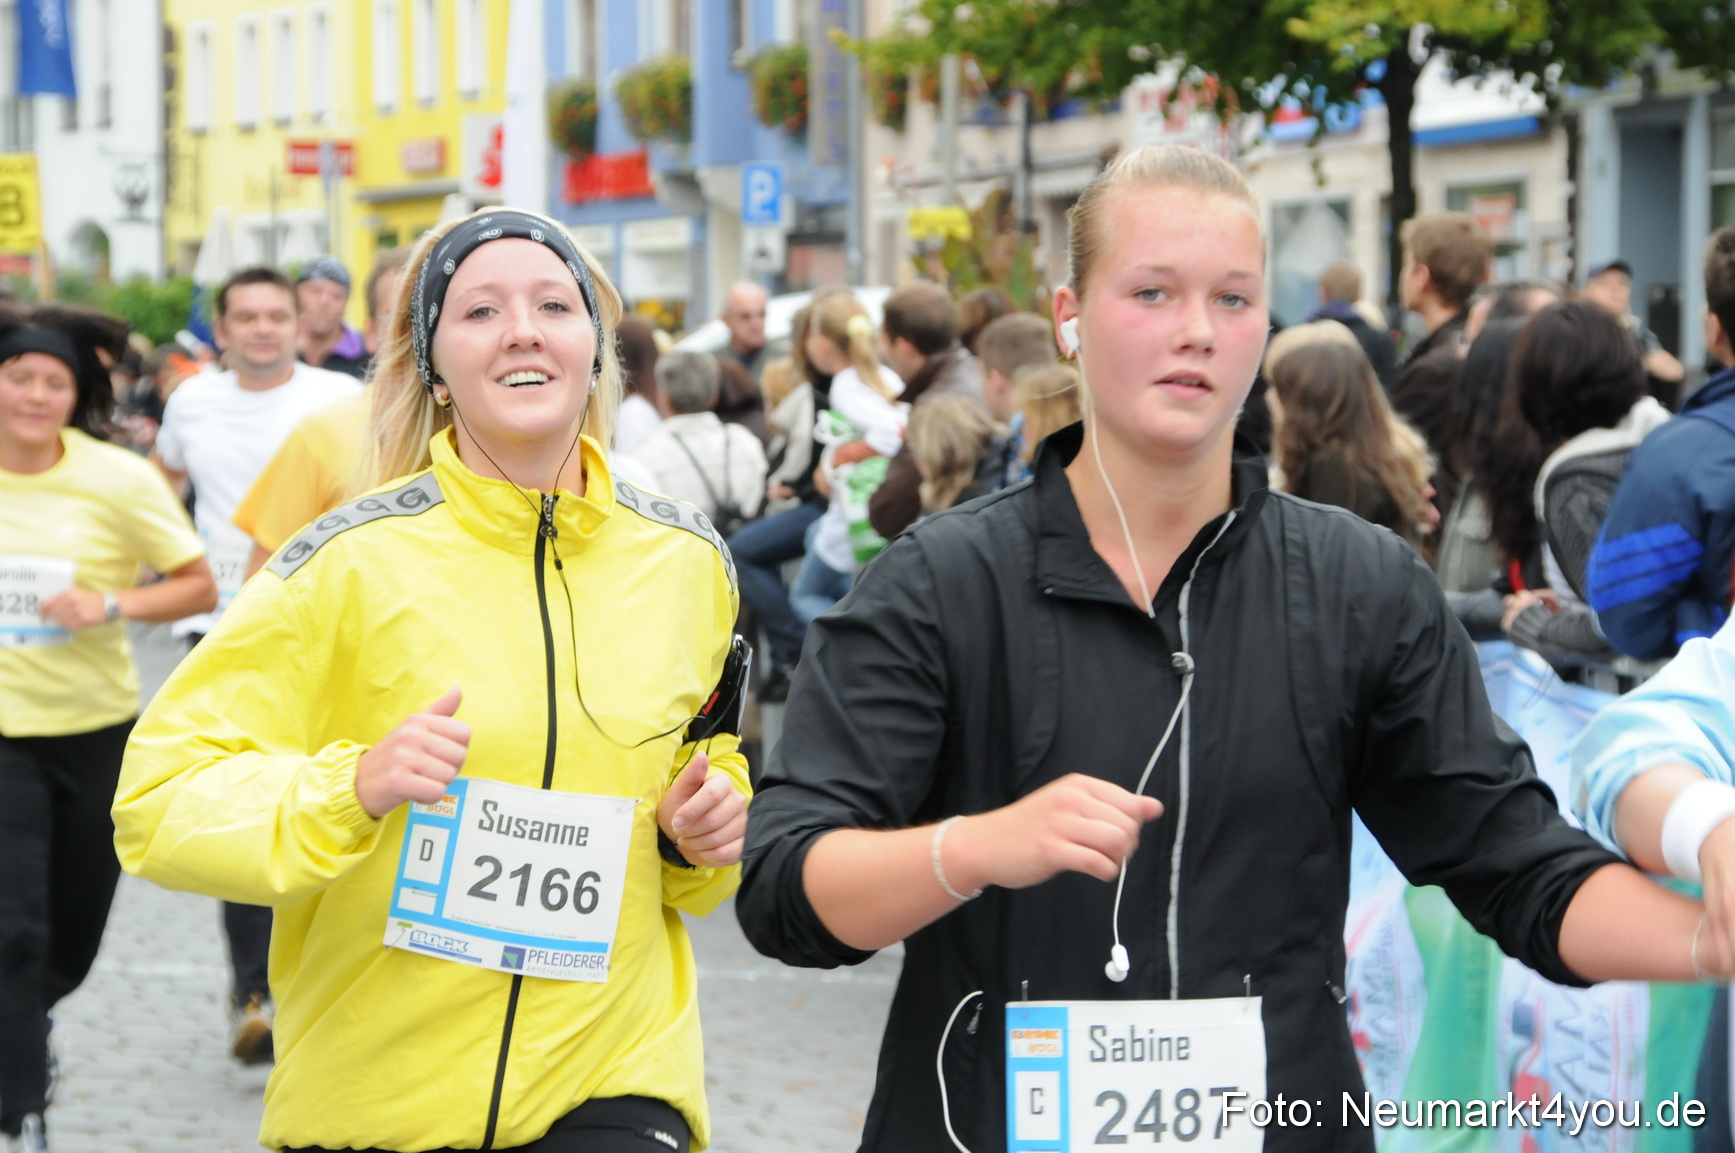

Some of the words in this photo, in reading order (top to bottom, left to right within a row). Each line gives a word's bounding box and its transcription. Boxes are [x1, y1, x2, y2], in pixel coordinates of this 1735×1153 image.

[478, 798, 590, 848] Susanne
[419, 838, 435, 862] D
[466, 855, 602, 916] 2166
[409, 929, 470, 954] BOCK
[527, 949, 605, 970] PFLEIDERER
[1089, 1025, 1191, 1063] Sabine
[1030, 1087, 1044, 1116] C
[1094, 1086, 1239, 1145] 2487
